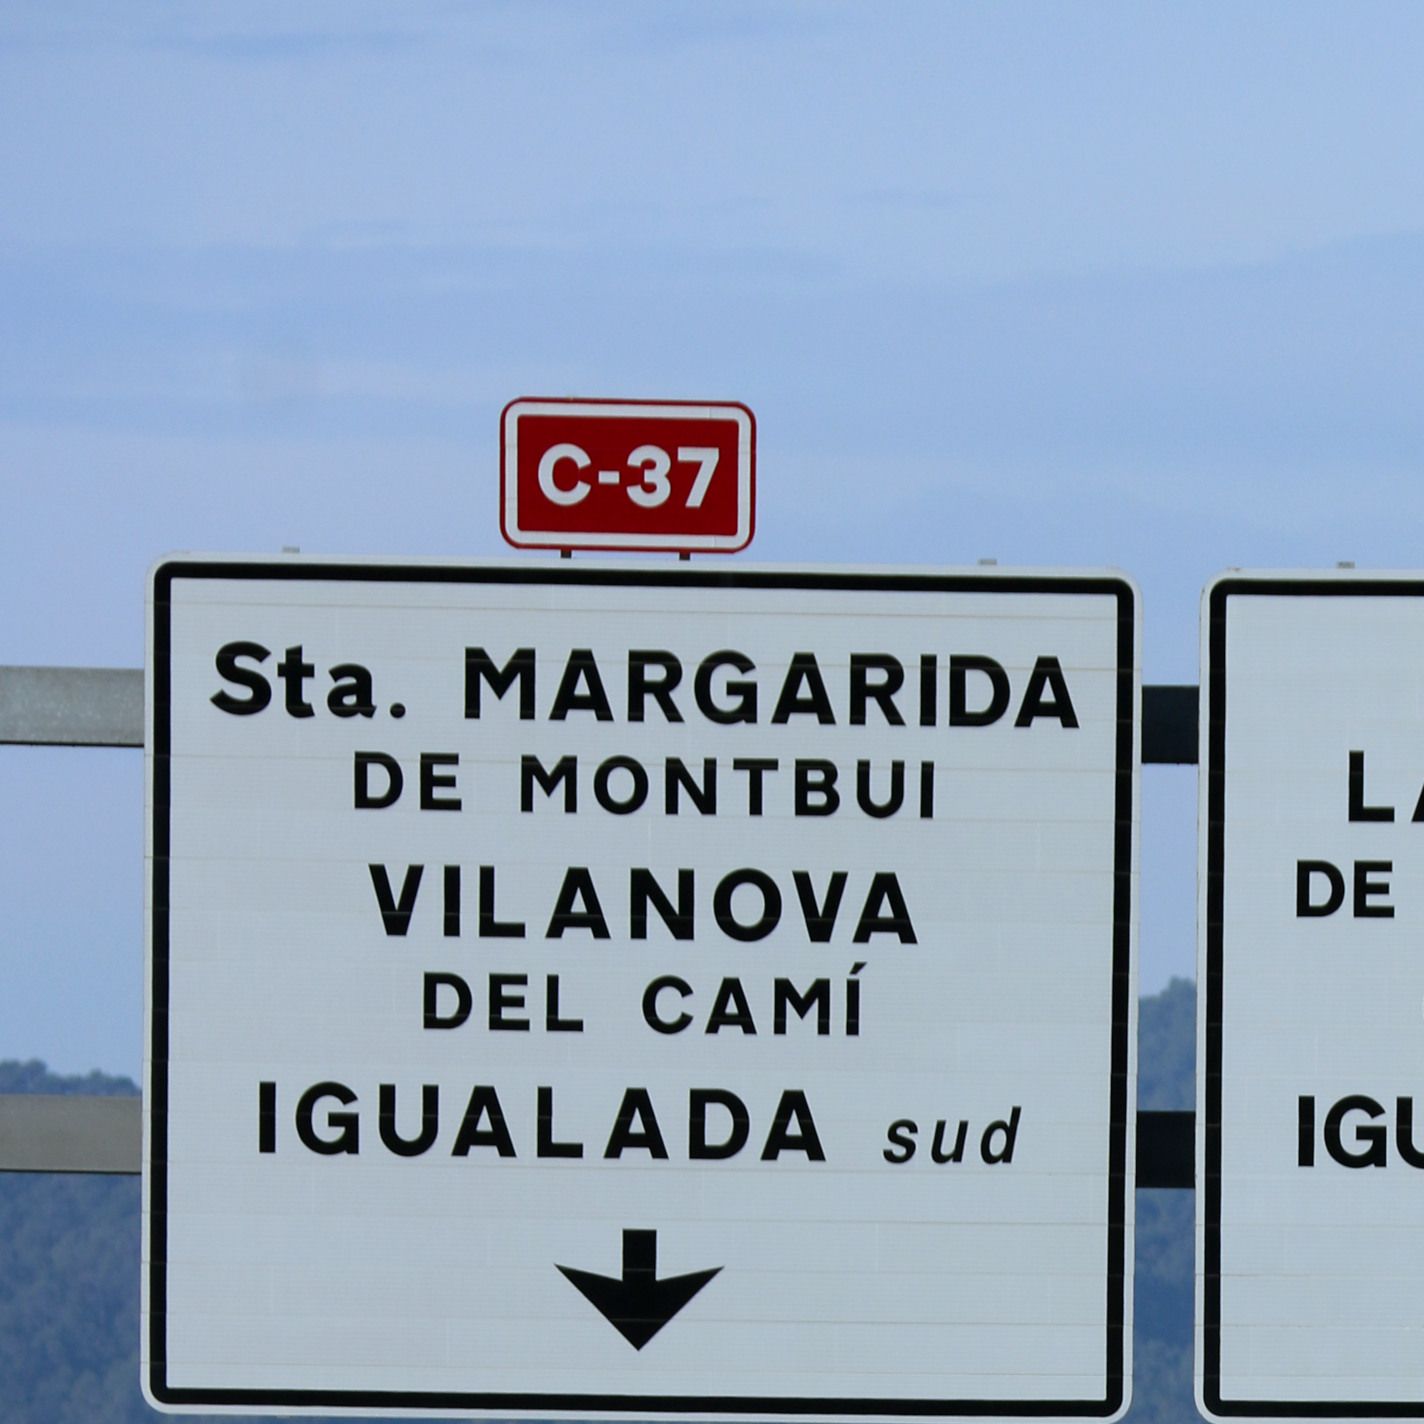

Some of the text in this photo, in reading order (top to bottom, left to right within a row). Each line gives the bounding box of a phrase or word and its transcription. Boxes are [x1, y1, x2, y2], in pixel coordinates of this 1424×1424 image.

[538, 443, 720, 508] C-37
[210, 641, 1079, 729] Sta. MARGARIDA
[355, 751, 935, 820] DE MONTBUI
[369, 864, 917, 945] VILANOVA
[1296, 860, 1395, 918] DE
[424, 962, 867, 1036] DEL CAMÍ
[259, 1081, 1022, 1164] IGUALADA sud
